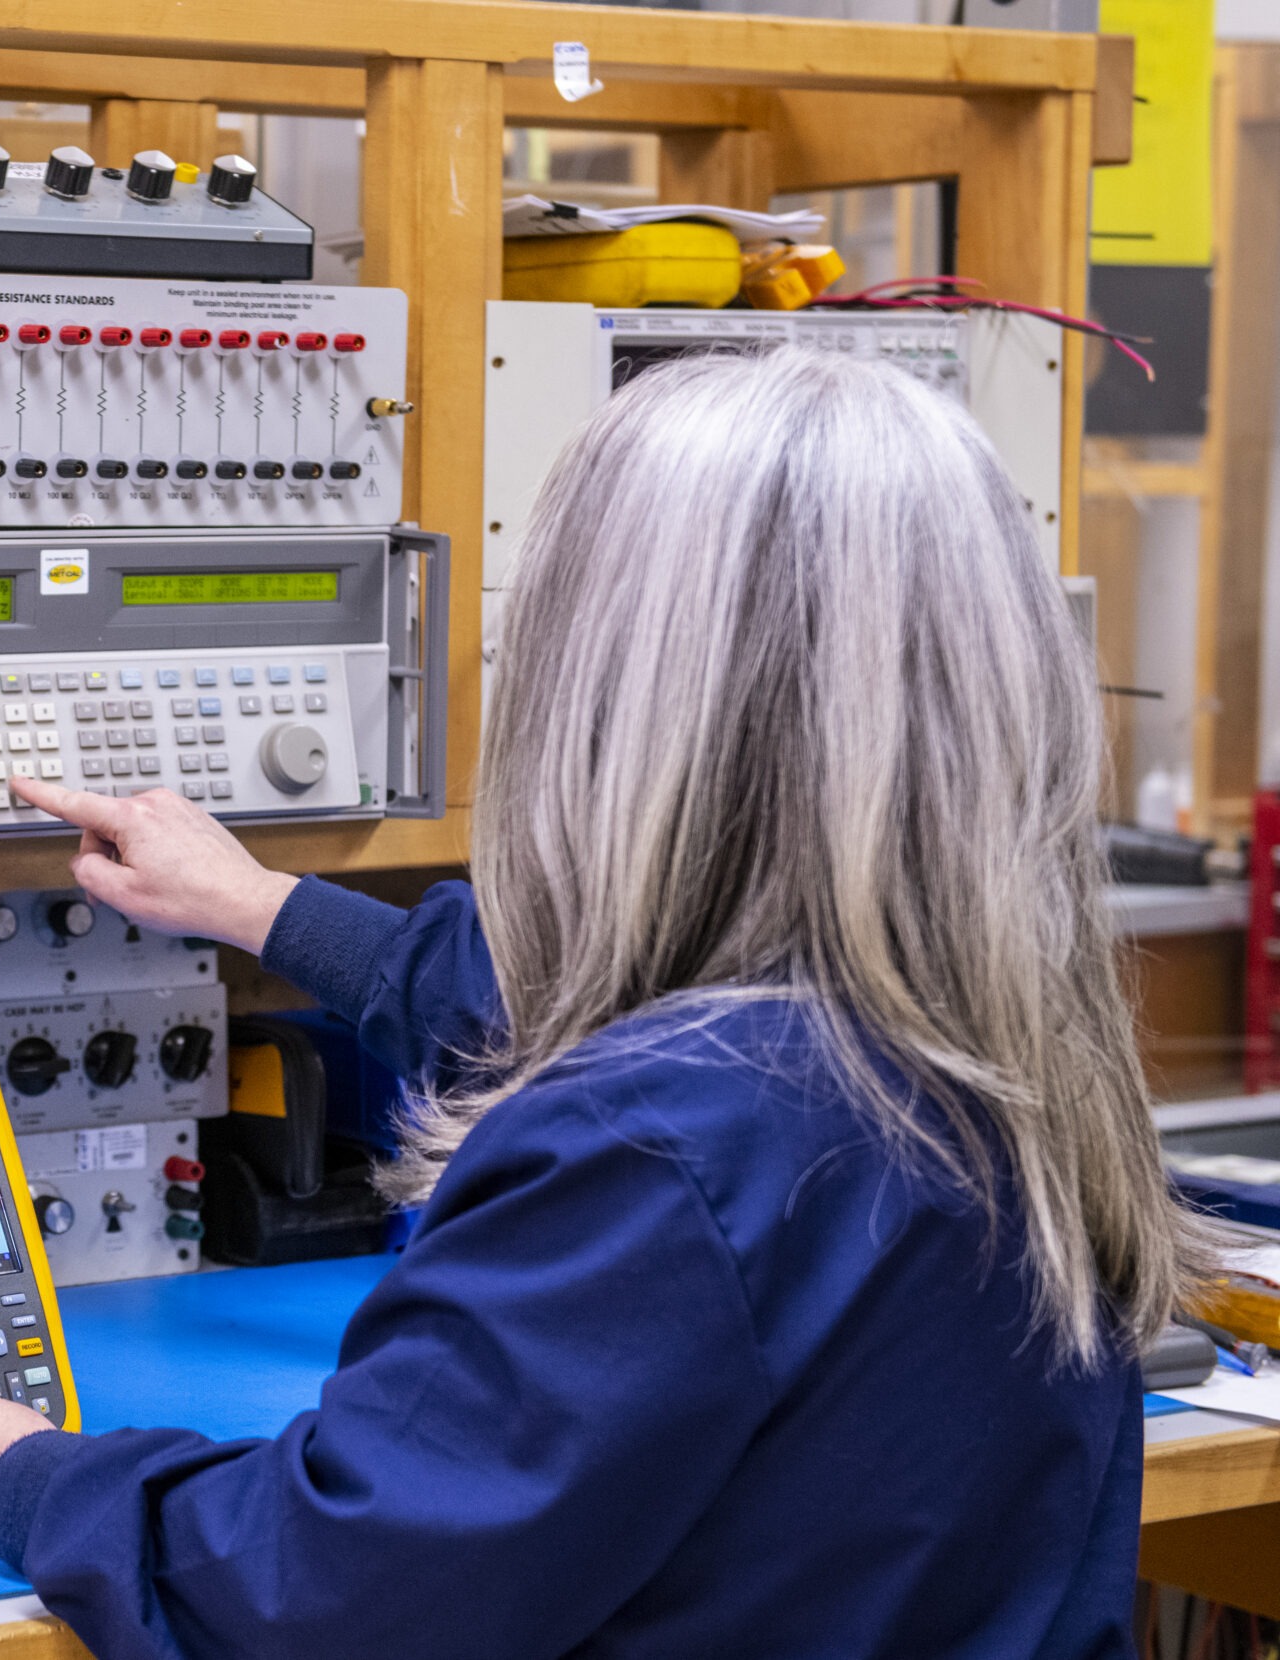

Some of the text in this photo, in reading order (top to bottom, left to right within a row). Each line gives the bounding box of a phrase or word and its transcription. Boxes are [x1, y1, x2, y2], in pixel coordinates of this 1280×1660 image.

[168, 288, 185, 297] Keep
[188, 288, 200, 296] unit
[216, 290, 238, 298] sealed
[240, 291, 281, 299] environment
[283, 292, 301, 300] when
[55, 294, 115, 306] STANDARDS
[224, 300, 249, 309] binding
[206, 310, 269, 319] minimum electrical
[365, 424, 382, 432] GND
[4, 1007, 26, 1017] CASE
[30, 1006, 52, 1016] MAY
[67, 1004, 85, 1013] HOT
[17, 1316, 35, 1324] ENTER
[22, 1342, 42, 1351] RECORD
[32, 1370, 48, 1381] AUTO
